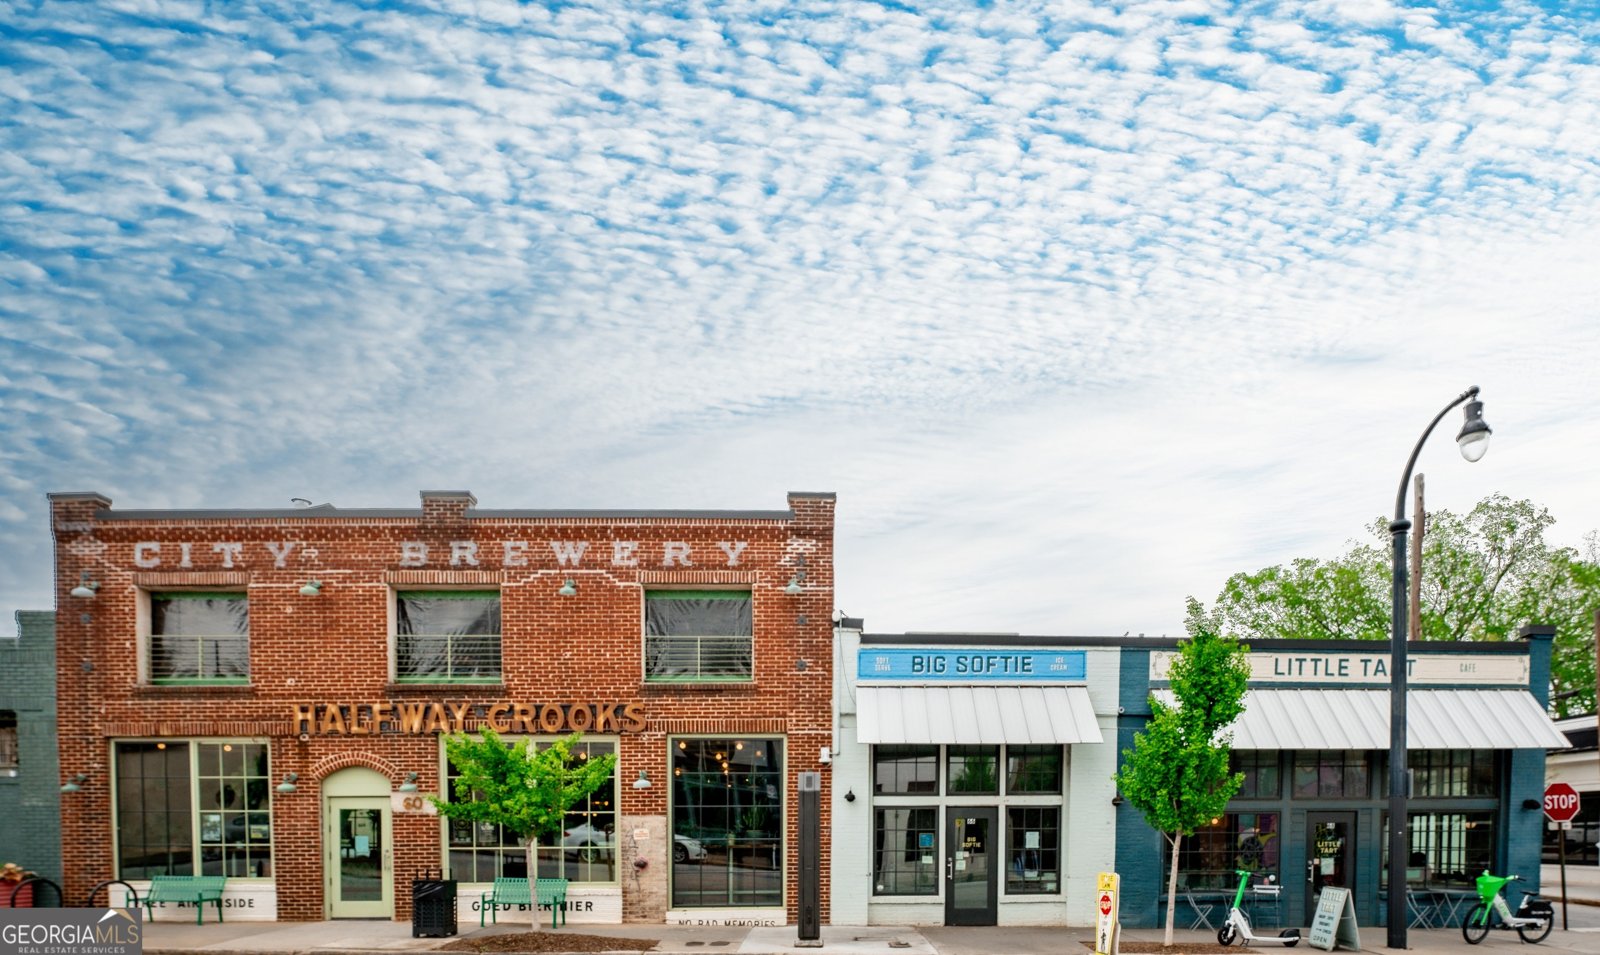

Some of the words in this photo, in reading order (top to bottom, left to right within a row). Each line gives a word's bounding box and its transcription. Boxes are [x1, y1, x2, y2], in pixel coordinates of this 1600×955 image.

[134, 541, 296, 568] CITY
[400, 540, 749, 567] BREWERY
[911, 655, 947, 675] BIG
[955, 655, 1034, 675] SOFTIE
[1274, 658, 1349, 676] LITTLE
[1360, 658, 1416, 677] TAT
[1459, 662, 1477, 673] CAFE
[292, 701, 471, 736] HALFWAY
[487, 701, 647, 734] CROOKS
[403, 796, 423, 810] 60
[1544, 794, 1577, 810] STOP
[211, 898, 254, 908] ISIDE
[519, 902, 551, 911] BIR
